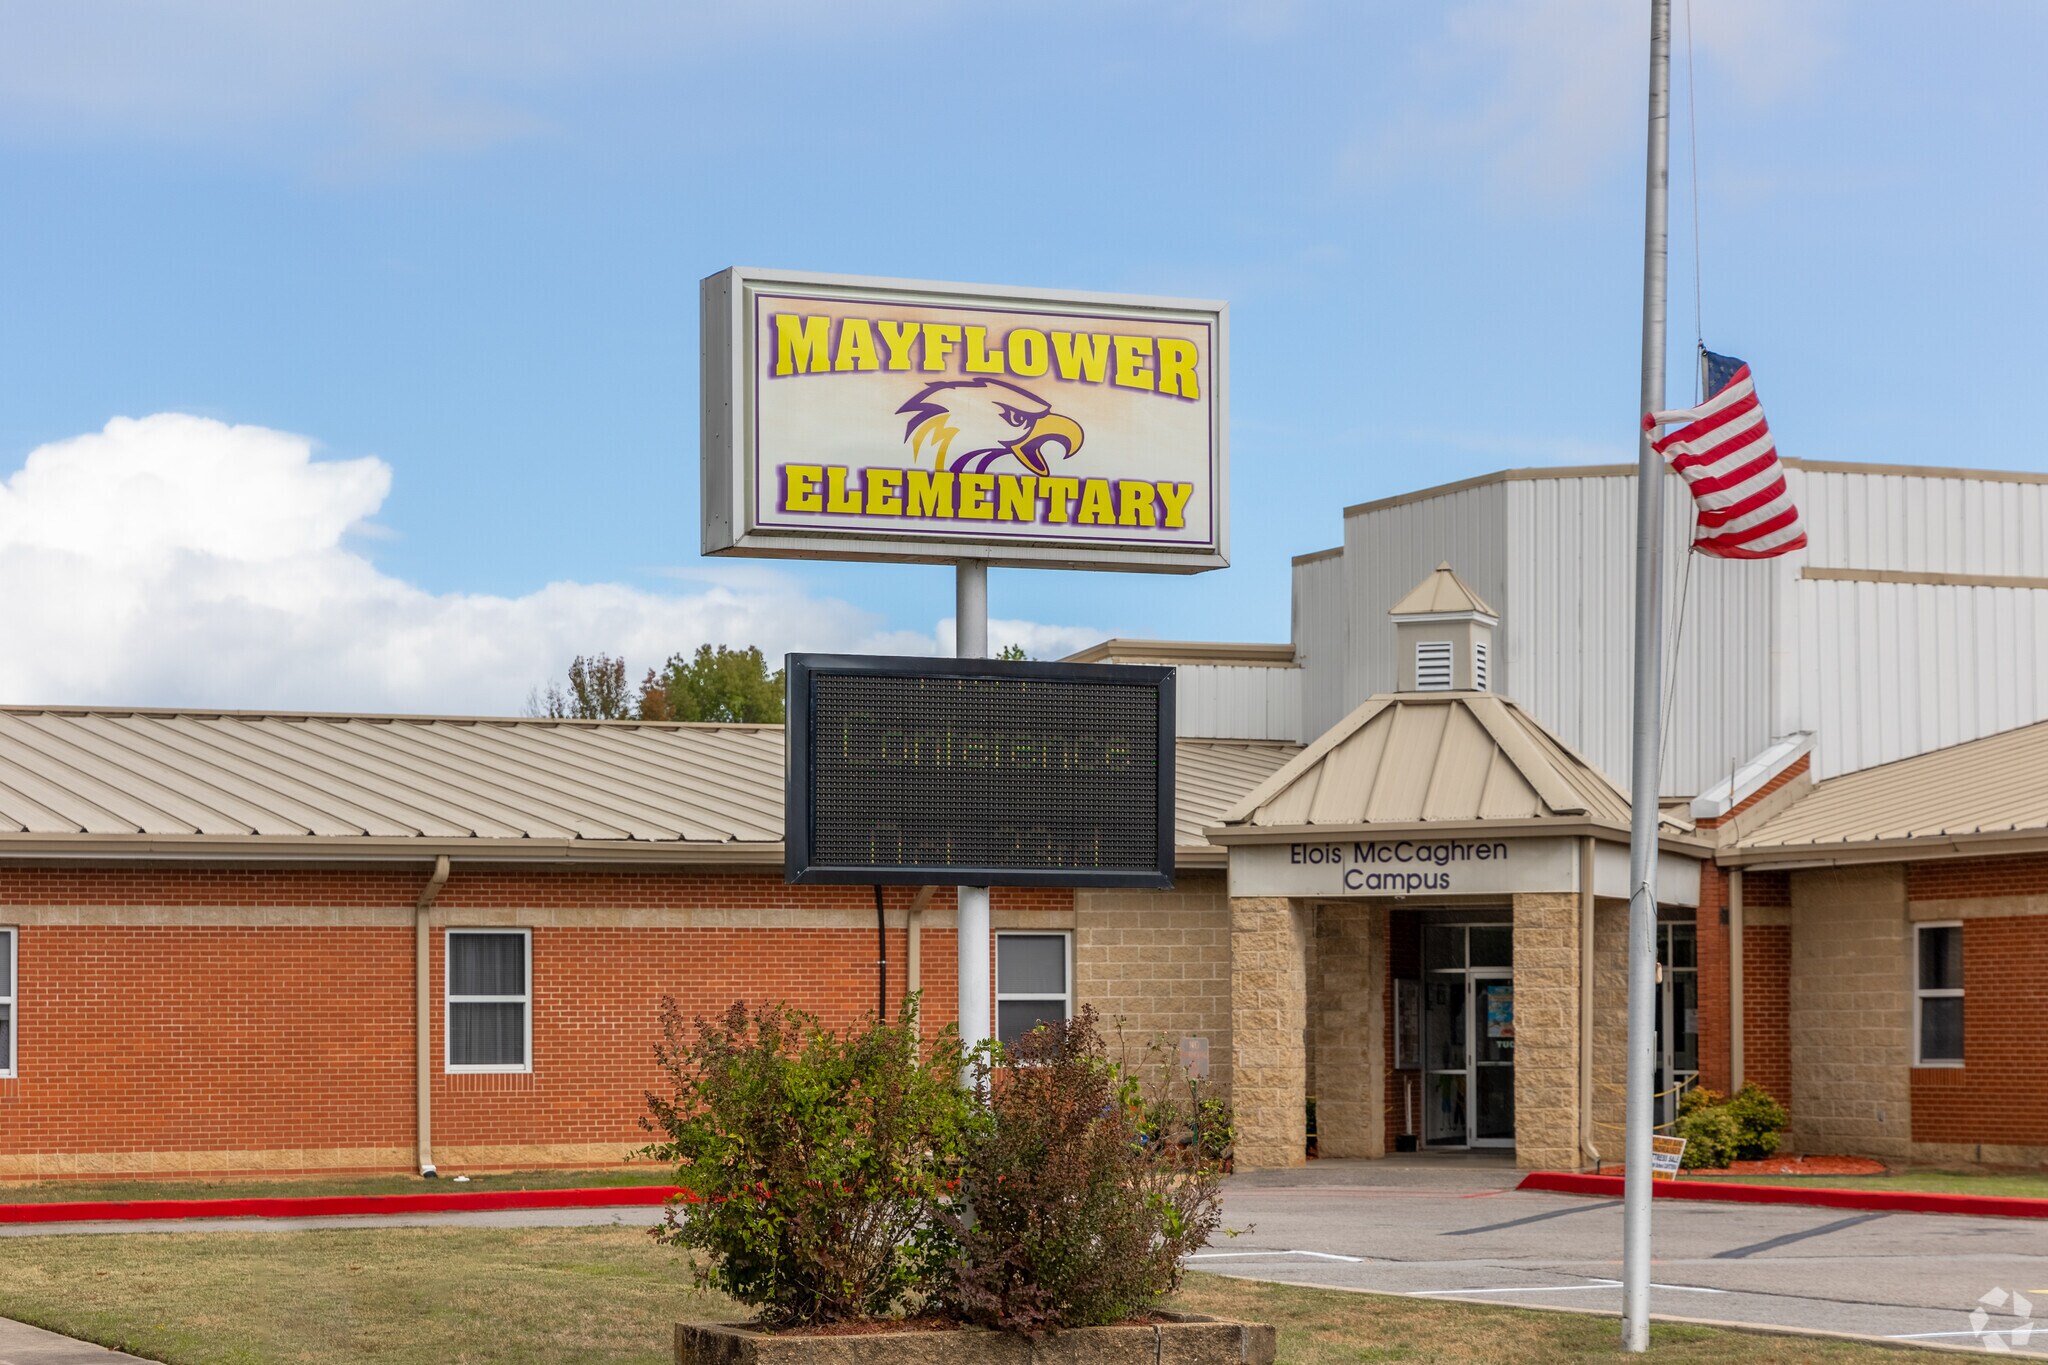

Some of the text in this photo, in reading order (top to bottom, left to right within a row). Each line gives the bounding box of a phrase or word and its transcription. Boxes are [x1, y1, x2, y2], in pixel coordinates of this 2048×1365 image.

[772, 313, 1201, 401] MAYFLOWER
[780, 464, 1194, 529] ELEMENTARY
[1290, 840, 1508, 866] Elois McCaghren
[1344, 868, 1451, 894] Campus
